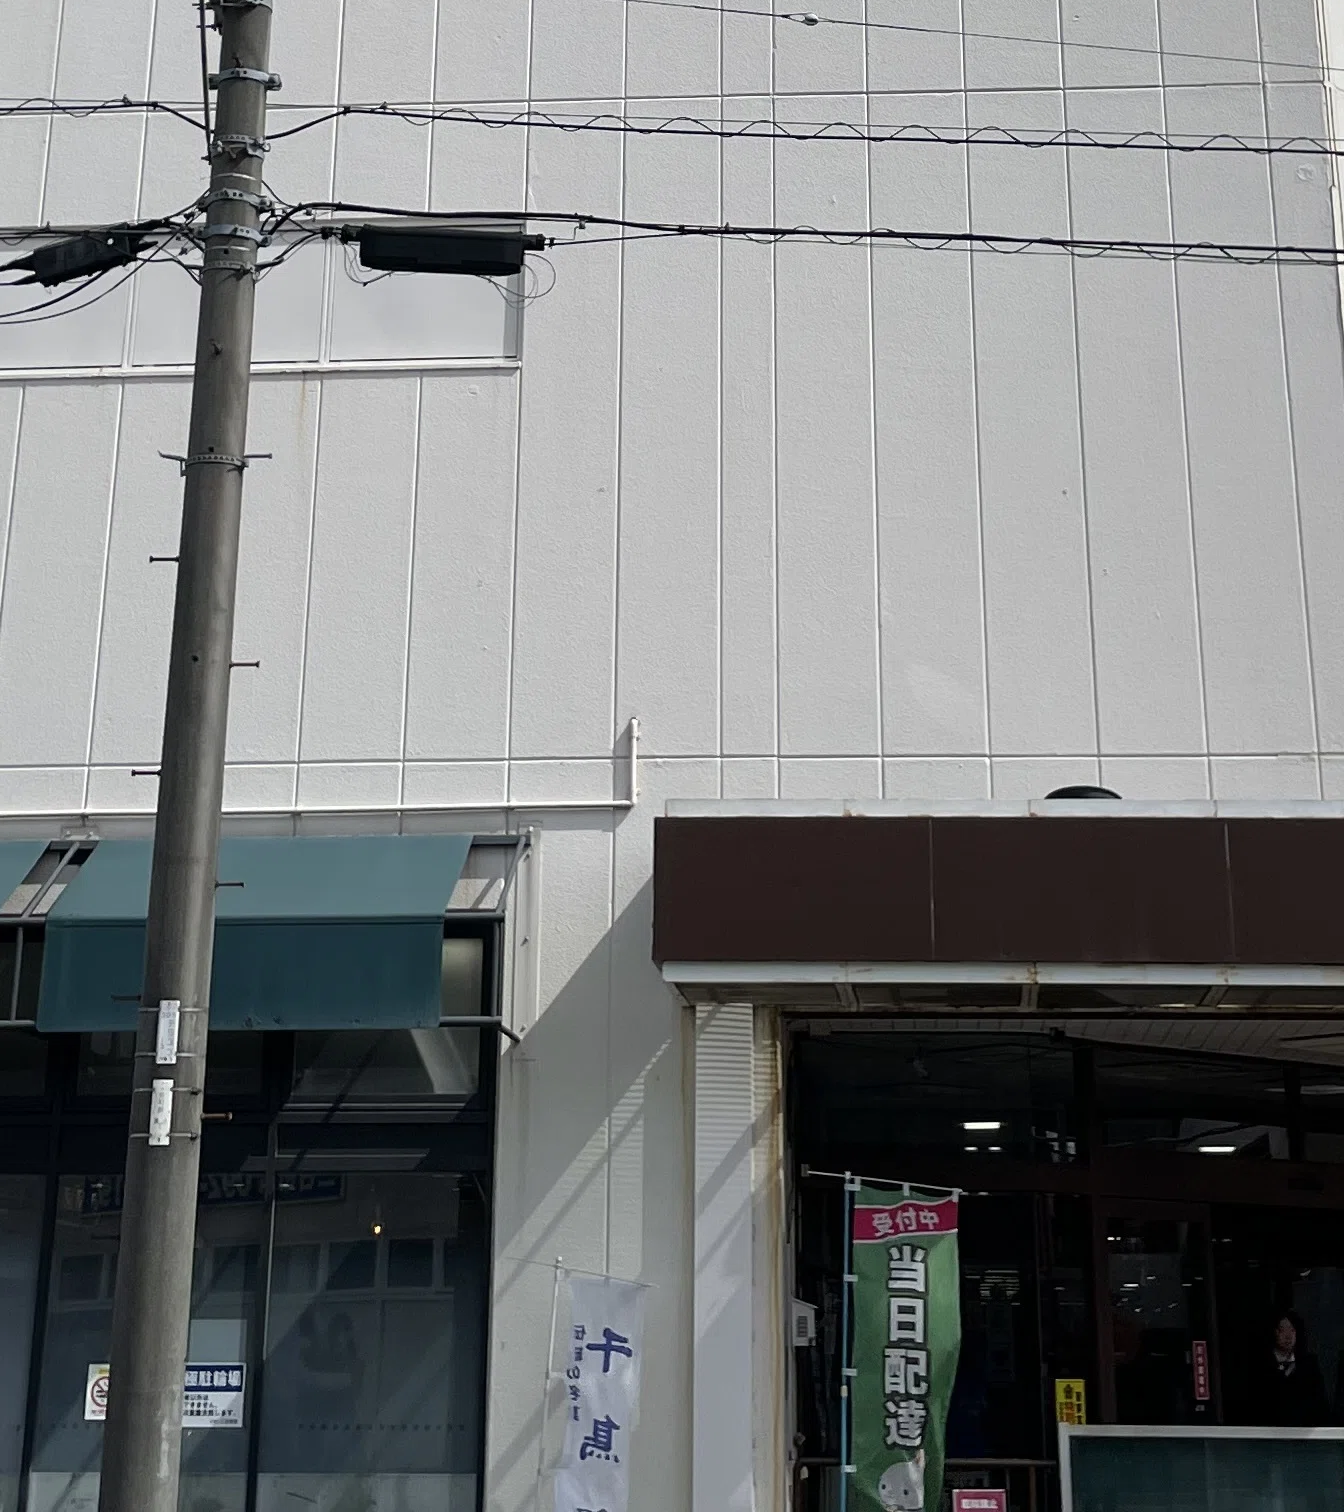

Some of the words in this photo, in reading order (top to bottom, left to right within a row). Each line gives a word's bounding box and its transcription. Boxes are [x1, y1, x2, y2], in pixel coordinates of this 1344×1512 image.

[872, 1207, 940, 1238] 受付中
[884, 1245, 929, 1448] 当日配達
